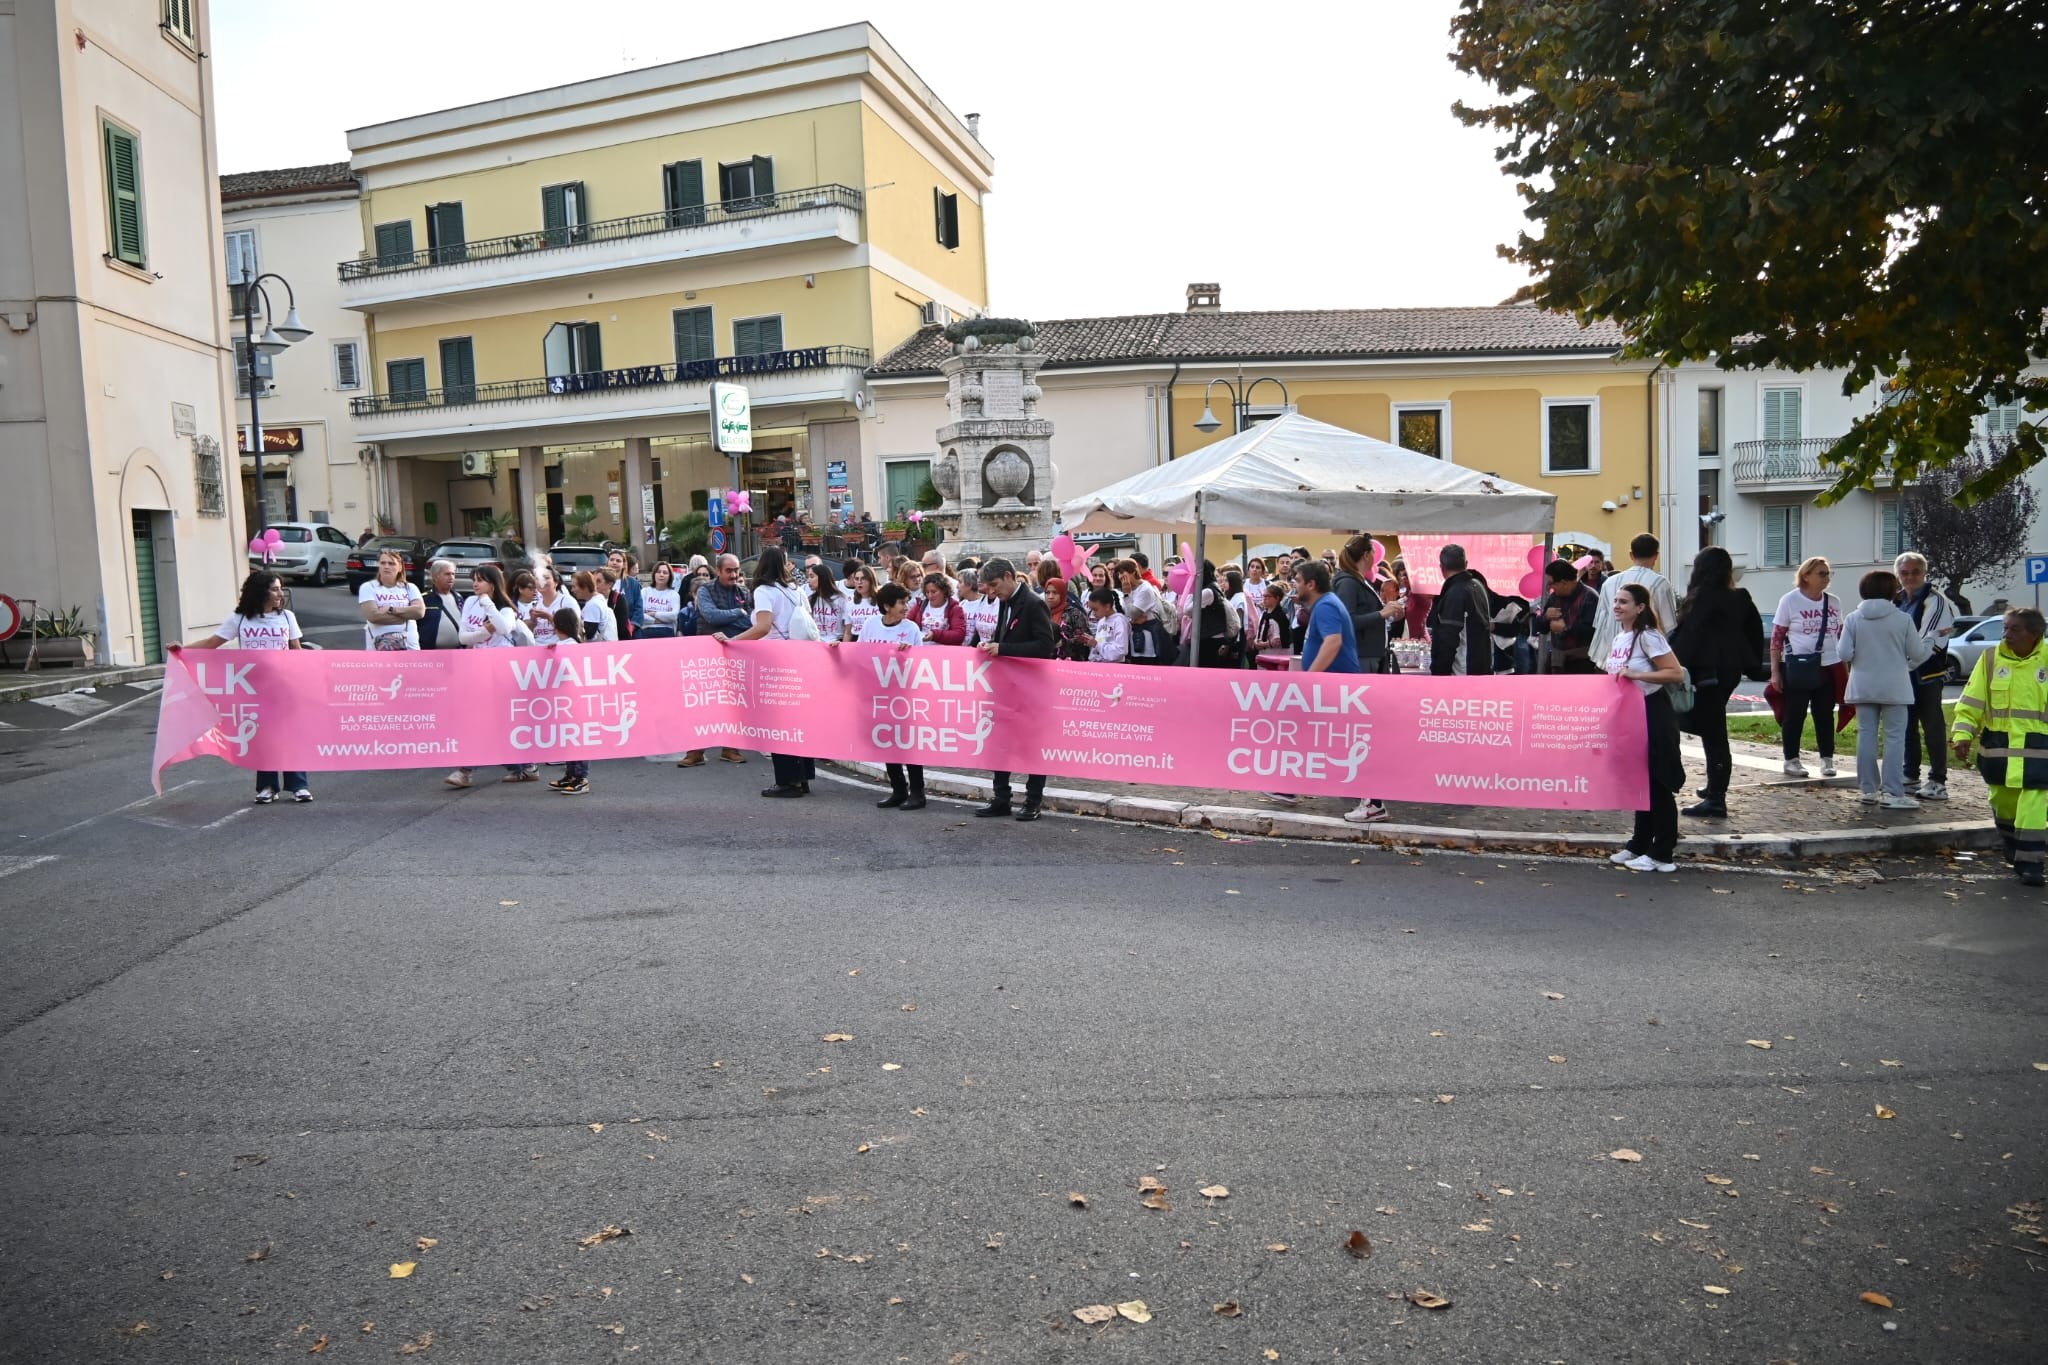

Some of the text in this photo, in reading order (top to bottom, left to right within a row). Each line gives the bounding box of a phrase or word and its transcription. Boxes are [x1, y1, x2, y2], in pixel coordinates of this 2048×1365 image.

[260, 433, 286, 445] orno
[2031, 559, 2046, 582] P
[375, 593, 409, 601] WALK
[244, 627, 288, 638] WALK
[1612, 648, 1632, 659] ALK
[509, 653, 636, 691] WALK
[680, 659, 696, 669] LA
[681, 667, 737, 681] PRECOCE
[196, 662, 257, 695] LK
[871, 656, 993, 693] WALK
[682, 682, 697, 692] LA
[698, 681, 721, 691] TUA
[510, 691, 638, 722] FOR THE
[684, 689, 748, 708] DIFESA
[1229, 681, 1371, 715] WALK
[214, 703, 259, 727] HE
[340, 713, 437, 724] LA PREVENZIONE
[871, 695, 995, 723] FOR THE
[1419, 698, 1514, 719] SAPERE
[1550, 704, 1561, 712] 20
[1578, 705, 1590, 713] 40
[1591, 704, 1608, 713] anni
[362, 723, 401, 731] SALVARE
[402, 722, 414, 730] LA
[416, 722, 436, 730] VITA
[693, 720, 804, 744] www.komen.it
[1062, 719, 1155, 734] LA PREVENZIONE
[1230, 718, 1373, 749] FOR THE
[1418, 718, 1441, 729] CHE
[1442, 718, 1478, 730] ESISTE
[1479, 720, 1502, 732] NON
[509, 721, 603, 750] CURE
[871, 724, 959, 753] CURE
[1082, 730, 1119, 740] SALVARE
[1120, 732, 1132, 740] LA
[1134, 733, 1153, 742] VITA
[1418, 730, 1513, 747] ABBASTANZA
[1591, 741, 1608, 749] anni
[317, 738, 459, 758] www.komen.it
[1041, 746, 1174, 770] www.komen.it
[1227, 748, 1328, 780] CURE
[1434, 771, 1589, 794] www.komen.it
